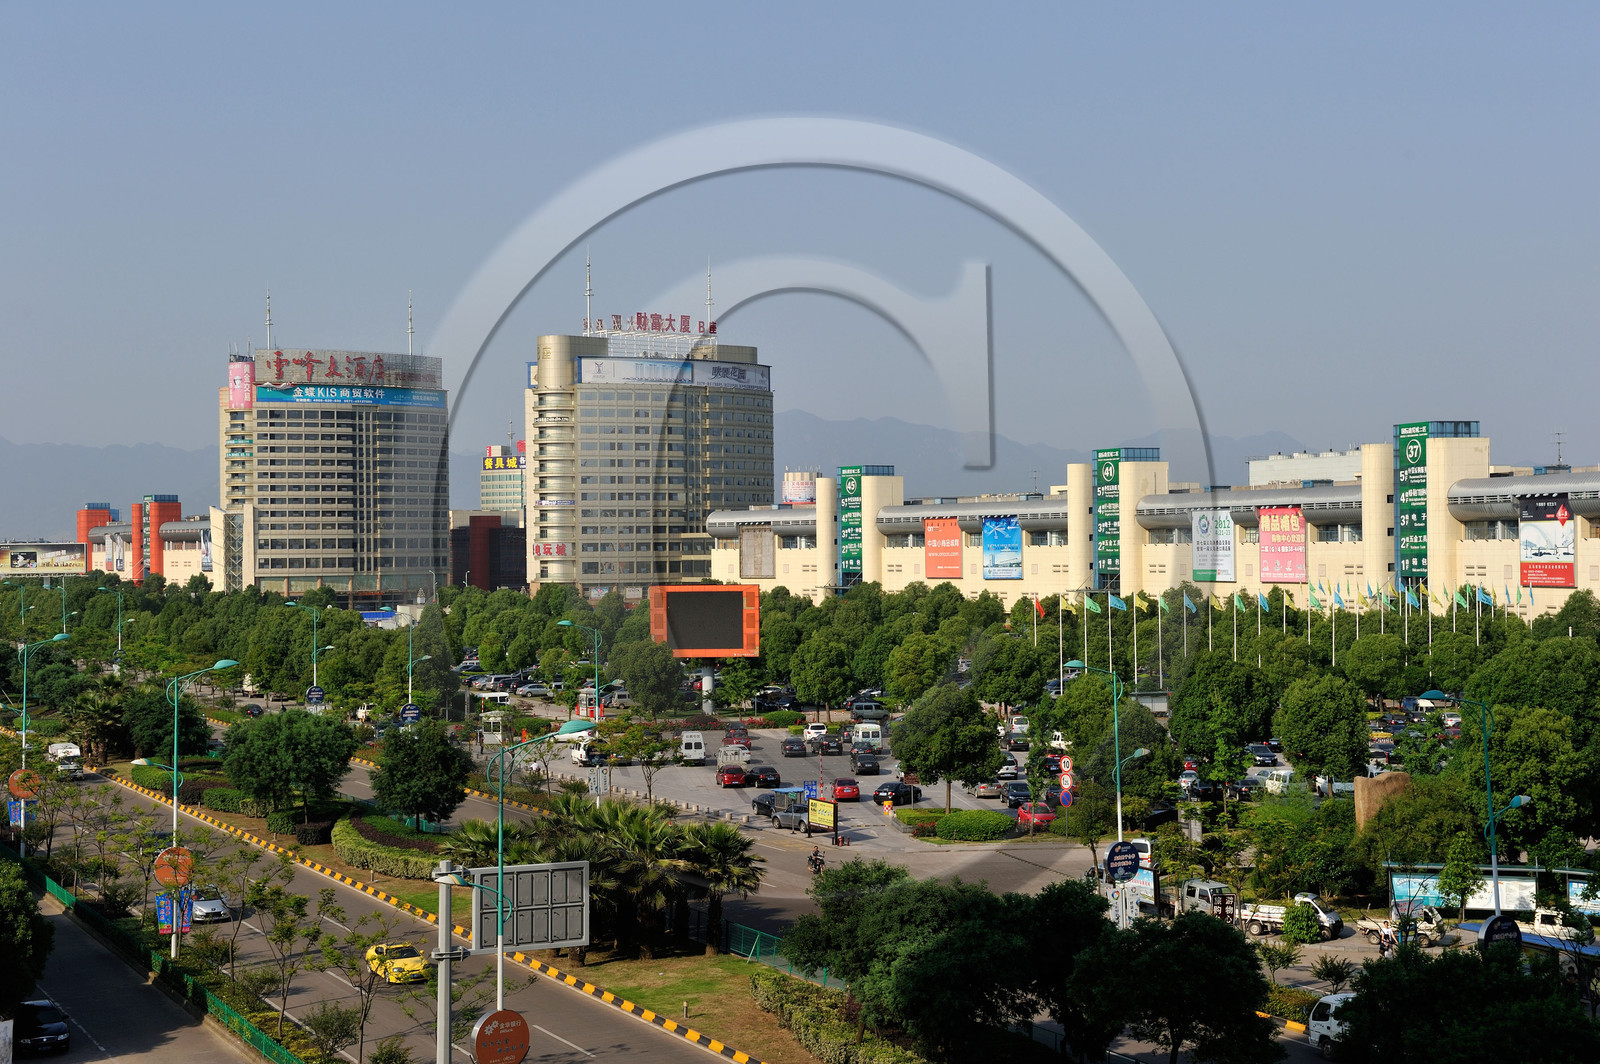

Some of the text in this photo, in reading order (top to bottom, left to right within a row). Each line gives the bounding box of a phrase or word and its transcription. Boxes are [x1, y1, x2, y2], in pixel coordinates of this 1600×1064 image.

[636, 312, 691, 334] 财富大厦
[293, 386, 385, 399] 金蝶KIS 商贸软件
[1408, 445, 1419, 458] 37
[484, 457, 518, 469] 餐具城
[1104, 467, 1113, 477] 41
[847, 481, 855, 491] 45
[1214, 519, 1231, 529] 2012
[1260, 514, 1300, 532] 精品箱包
[1063, 760, 1070, 769] 10
